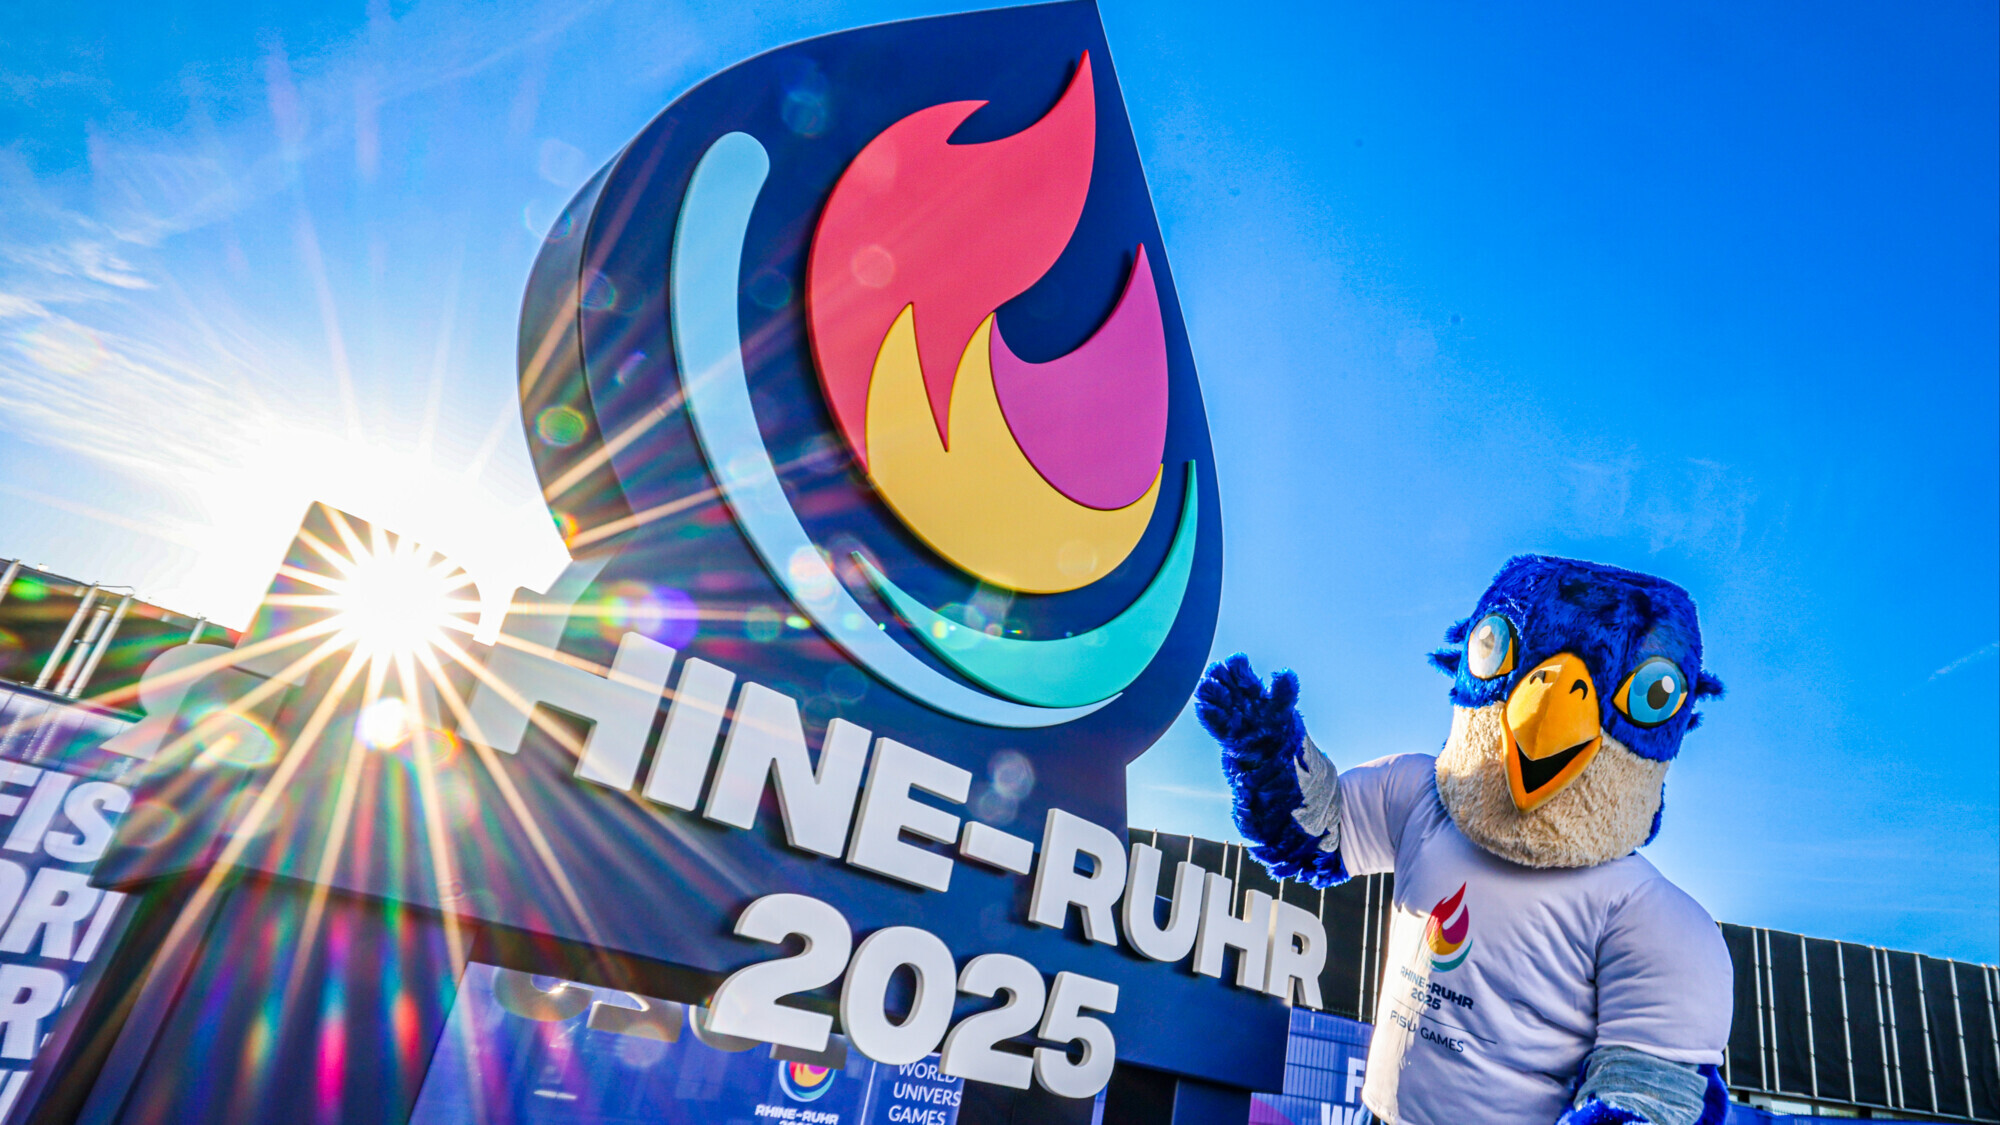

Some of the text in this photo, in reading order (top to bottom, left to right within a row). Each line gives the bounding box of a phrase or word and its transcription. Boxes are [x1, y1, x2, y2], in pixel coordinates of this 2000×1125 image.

[704, 893, 1119, 1099] 2025
[1401, 965, 1474, 1010] RHINE-RUHR
[1411, 987, 1442, 1011] 2025
[1390, 1009, 1464, 1053] FISU GAMES
[893, 1081, 962, 1107] UNIVERS
[754, 1103, 840, 1125] RHINE-RUHR
[888, 1104, 947, 1125] GAMES
